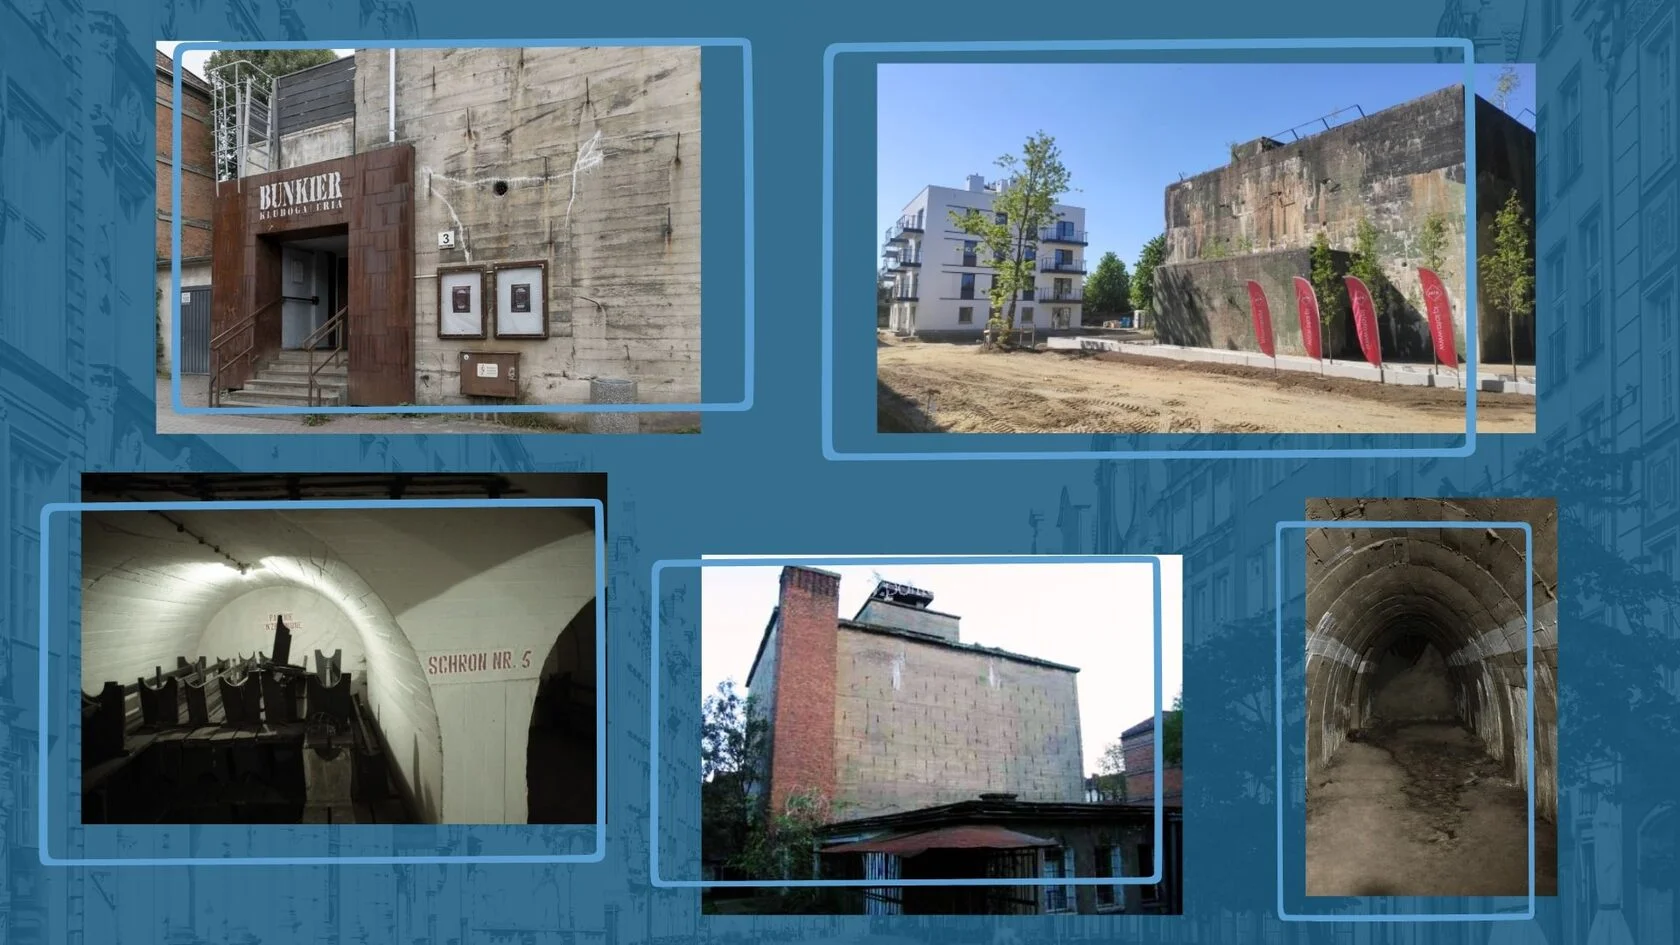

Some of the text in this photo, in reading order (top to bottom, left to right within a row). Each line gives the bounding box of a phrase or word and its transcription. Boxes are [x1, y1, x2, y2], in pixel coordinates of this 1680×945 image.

[260, 171, 342, 210] BUNKIER
[260, 200, 342, 220] KLUBOGAERIA
[442, 233, 450, 244] 3
[428, 650, 532, 675] SCHRON NR. 5
